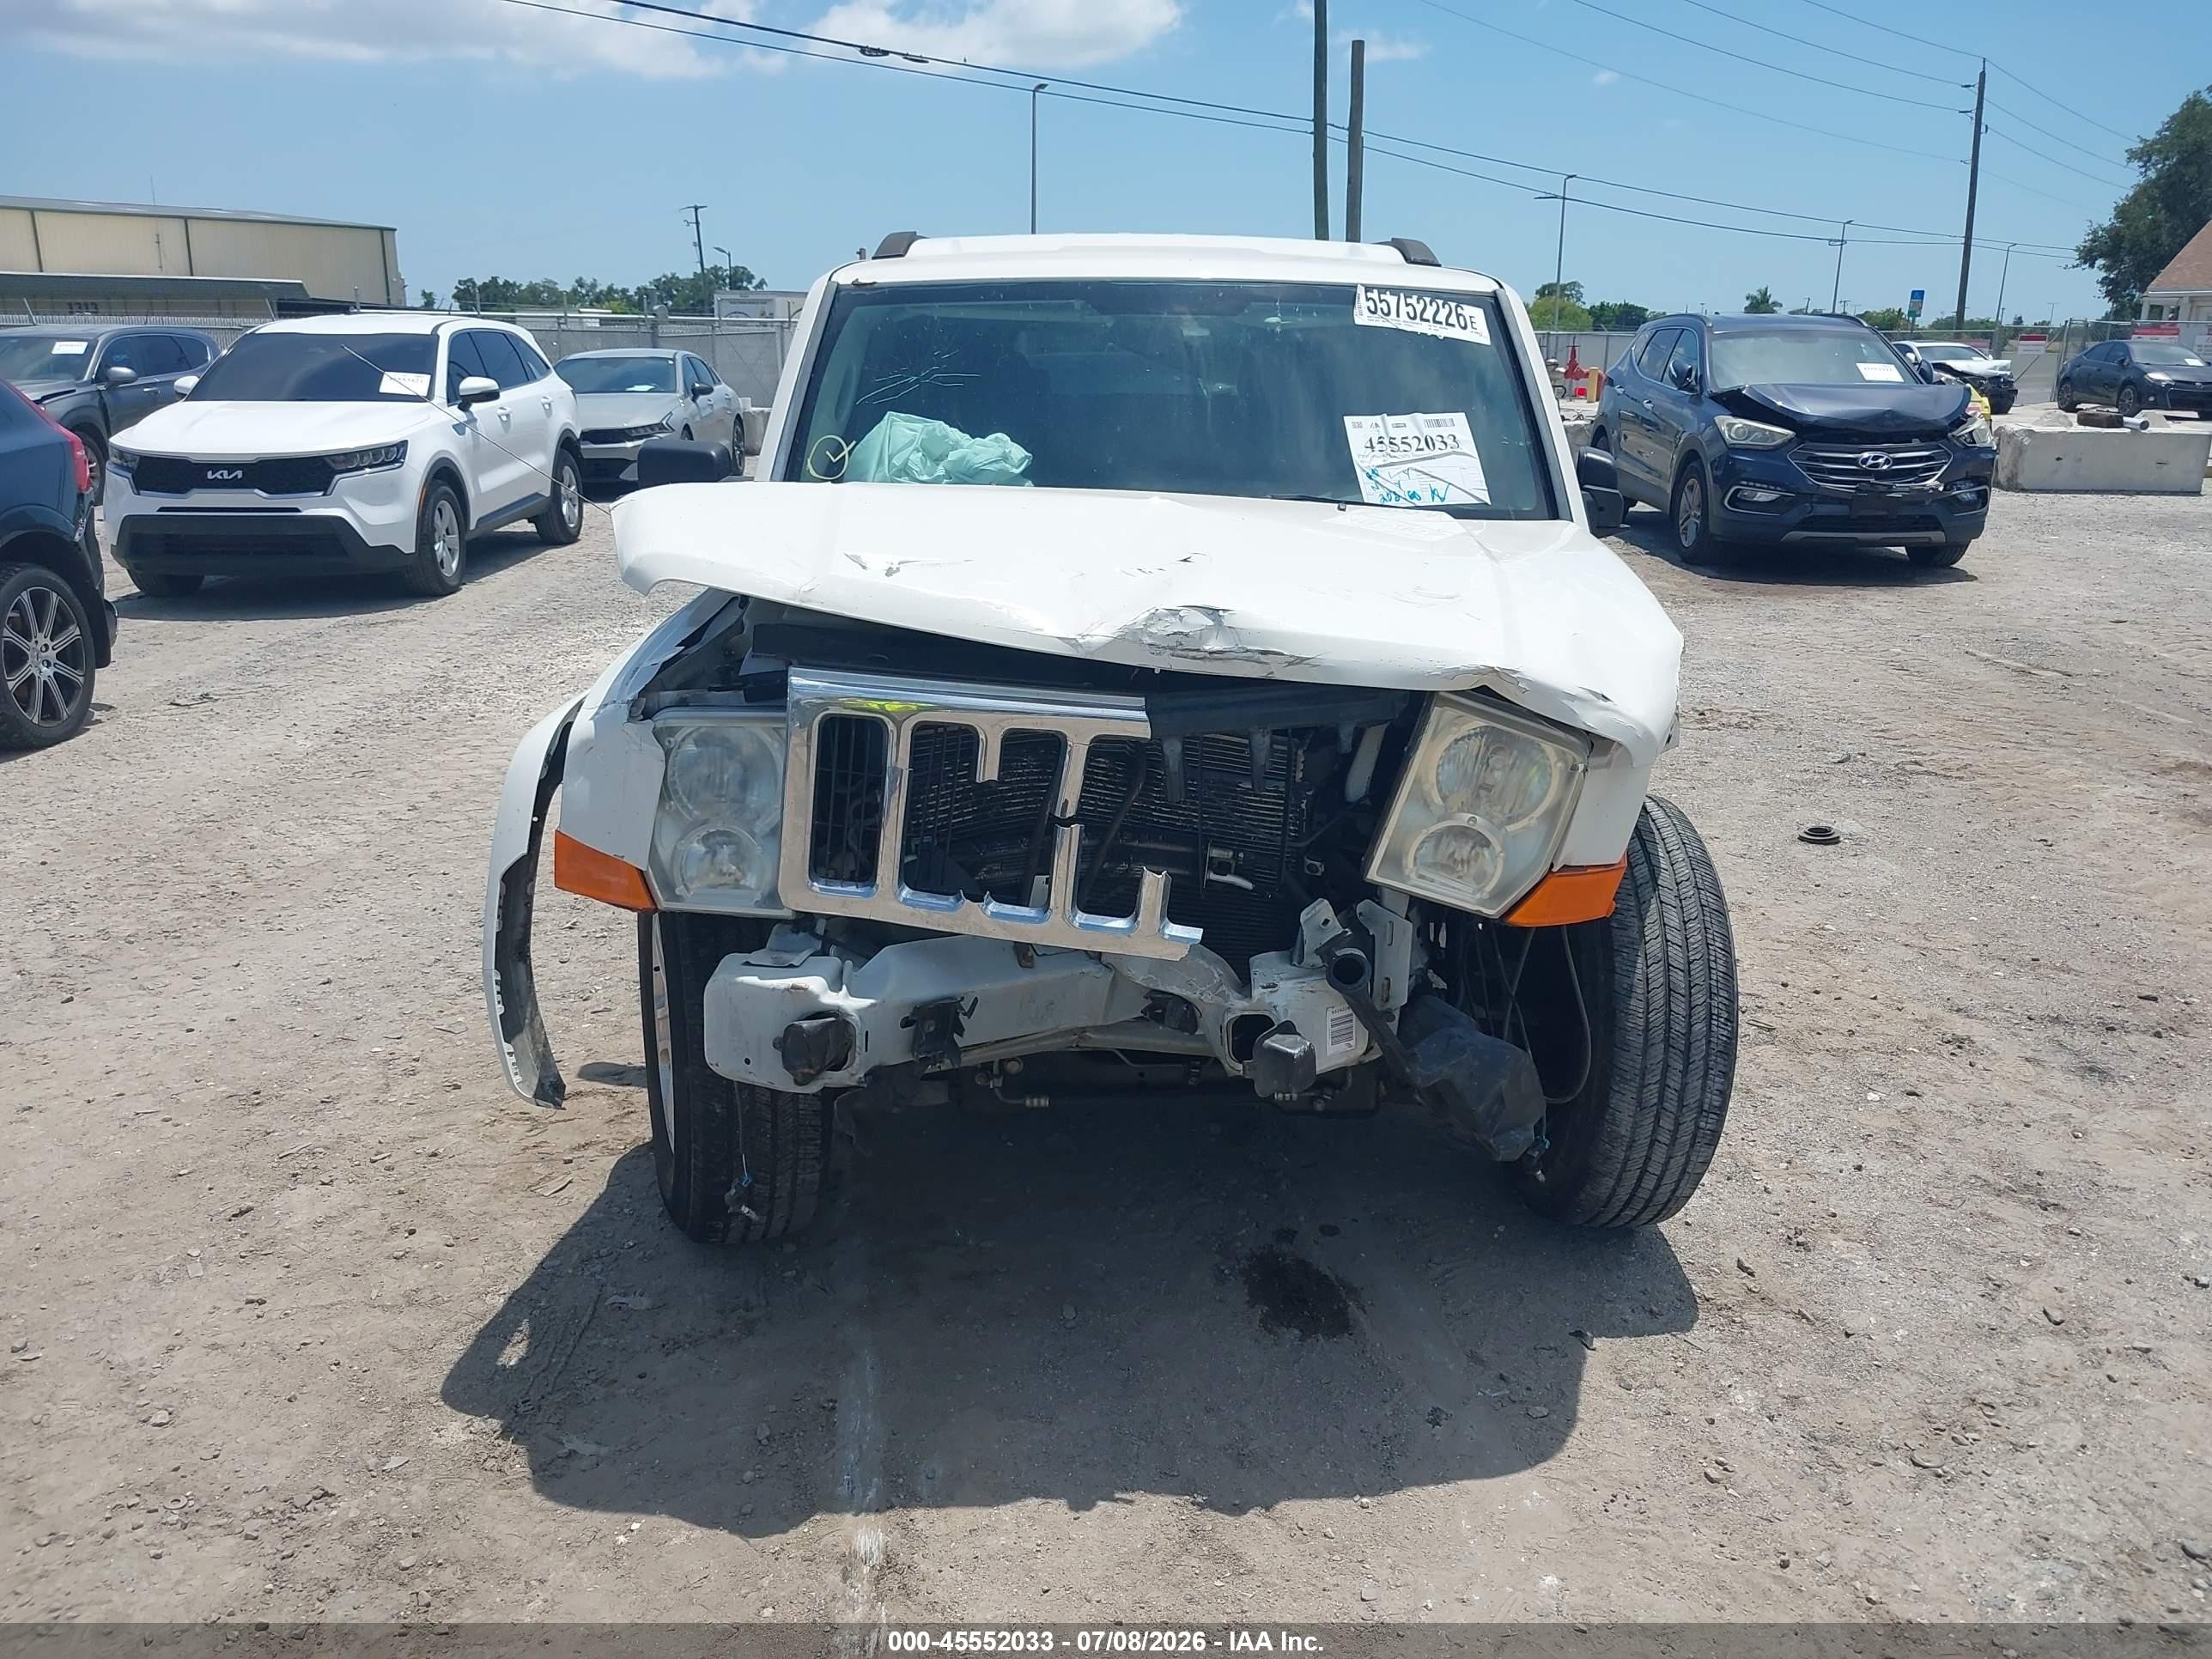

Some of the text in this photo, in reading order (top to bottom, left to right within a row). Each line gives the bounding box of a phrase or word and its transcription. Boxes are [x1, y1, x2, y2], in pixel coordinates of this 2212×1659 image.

[1364, 289, 1468, 331] 55752226
[1364, 434, 1460, 453] 45552033
[207, 470, 243, 479] KIA
